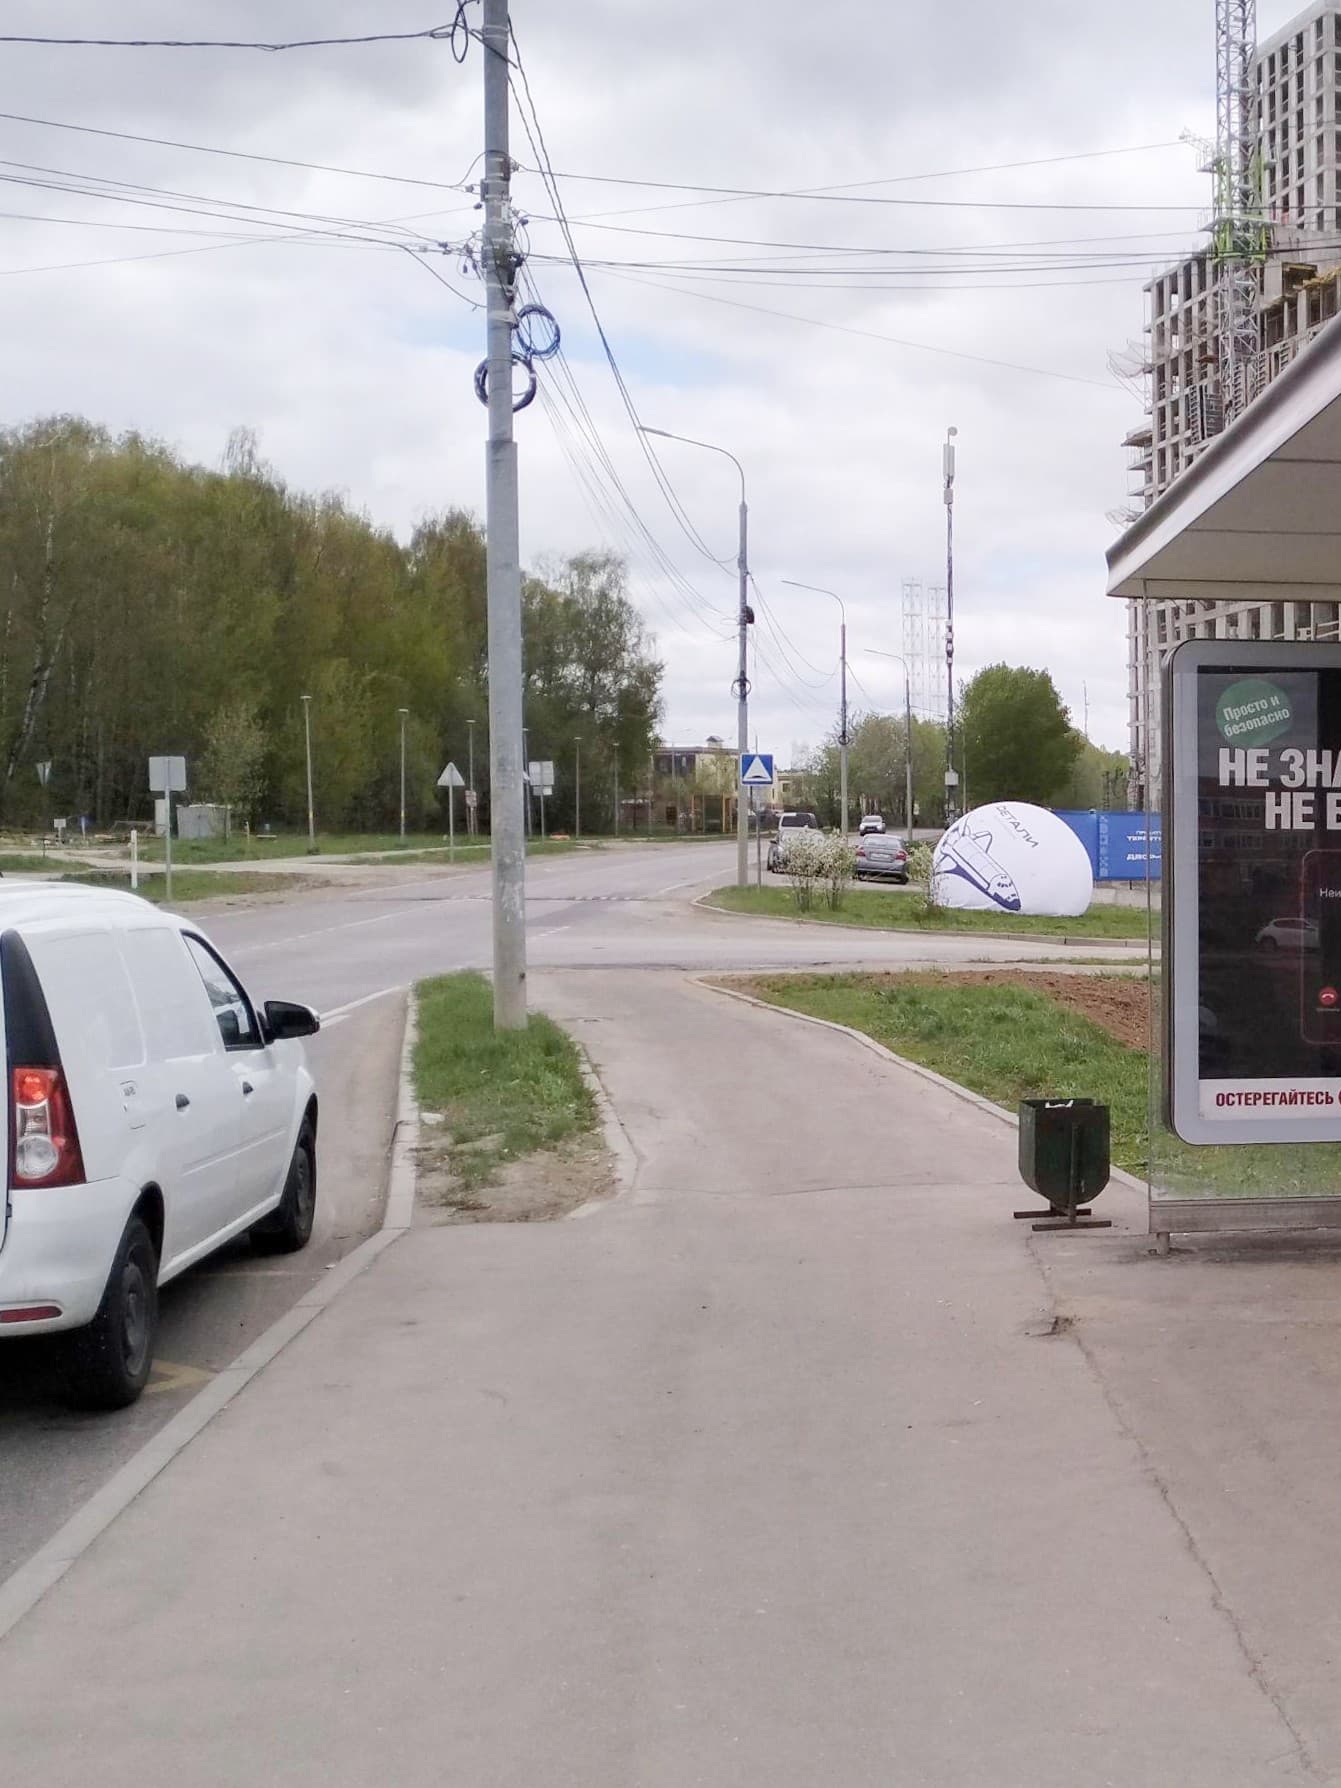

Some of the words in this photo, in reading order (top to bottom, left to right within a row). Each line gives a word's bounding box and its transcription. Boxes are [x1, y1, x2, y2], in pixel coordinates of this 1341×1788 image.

[1223, 699, 1269, 721] Просто
[1270, 695, 1281, 707] и
[1224, 708, 1291, 737] безопасно
[1218, 747, 1270, 787] НЕ
[1265, 791, 1316, 830] НЕ
[1215, 1088, 1335, 1107] ОСТЕРЕГАЙТЕСЬ
